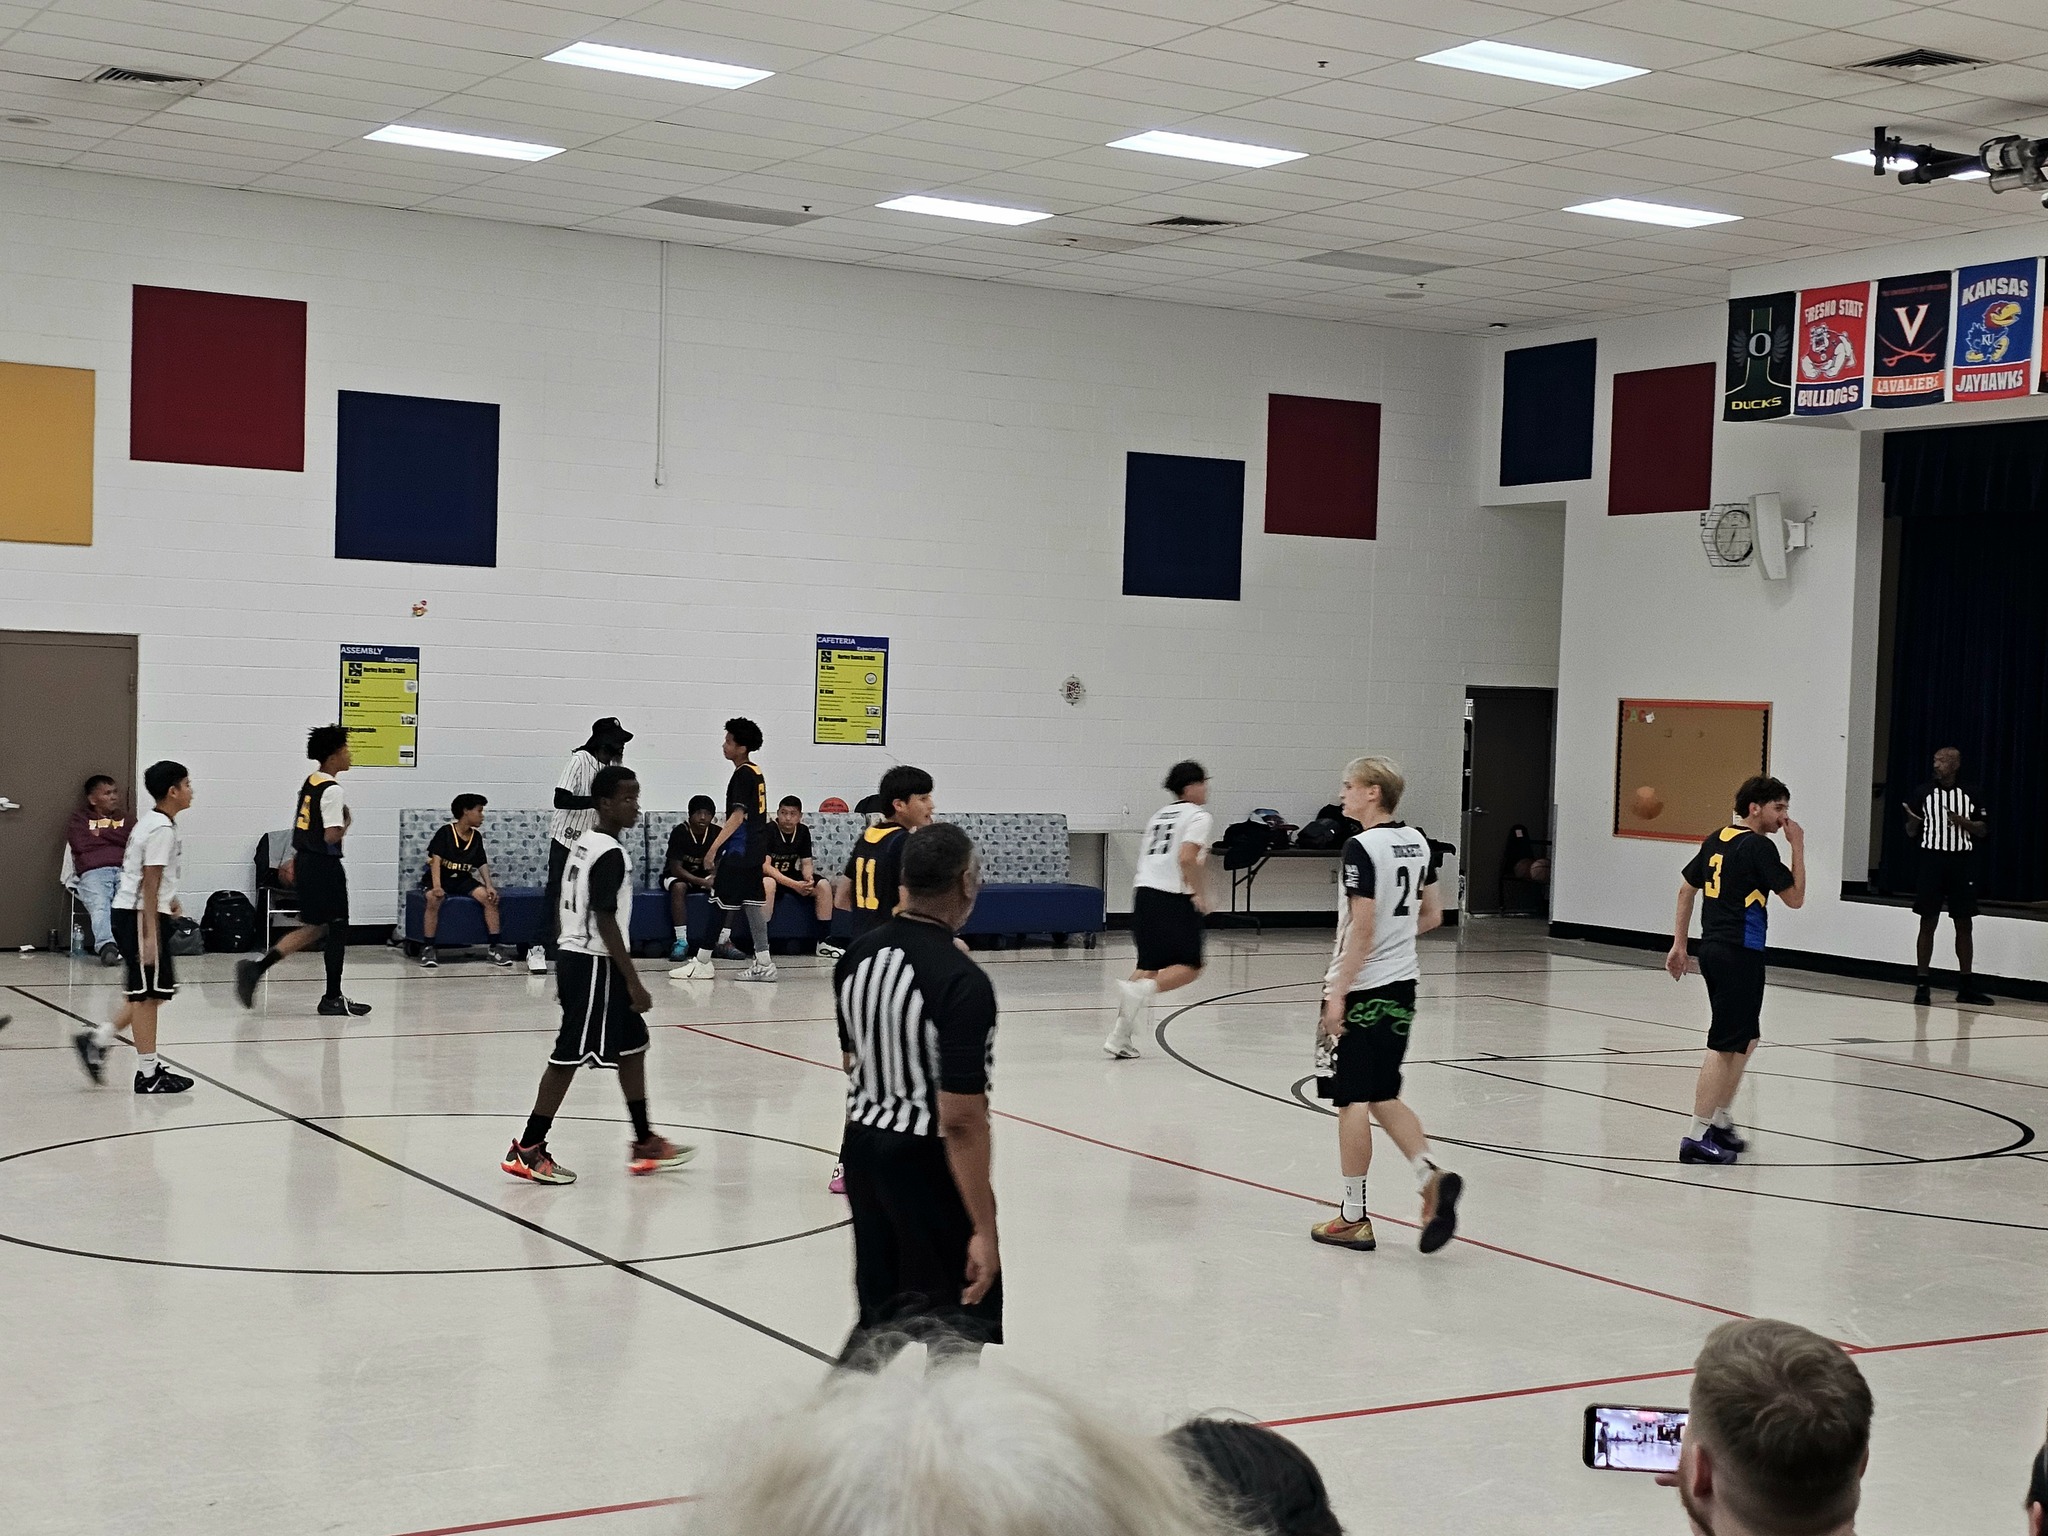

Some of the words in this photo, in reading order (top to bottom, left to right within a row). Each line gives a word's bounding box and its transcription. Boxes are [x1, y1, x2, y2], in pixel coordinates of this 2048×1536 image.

[1961, 277, 2029, 306] KANSAS
[1804, 299, 1837, 325] FRESNO
[1838, 298, 1864, 319] STATE
[1893, 303, 1930, 348] V
[1981, 333, 1995, 346] KU
[1876, 376, 1939, 394] CAVALIERS
[1955, 369, 2024, 393] JAYHAWKS
[1731, 396, 1782, 410] DUCKS
[1797, 385, 1859, 407] BULLDOGS
[340, 646, 384, 655] ASSEMBLY
[817, 636, 856, 645] CAFETERIA
[855, 856, 880, 911] 11
[1704, 852, 1724, 899] 3
